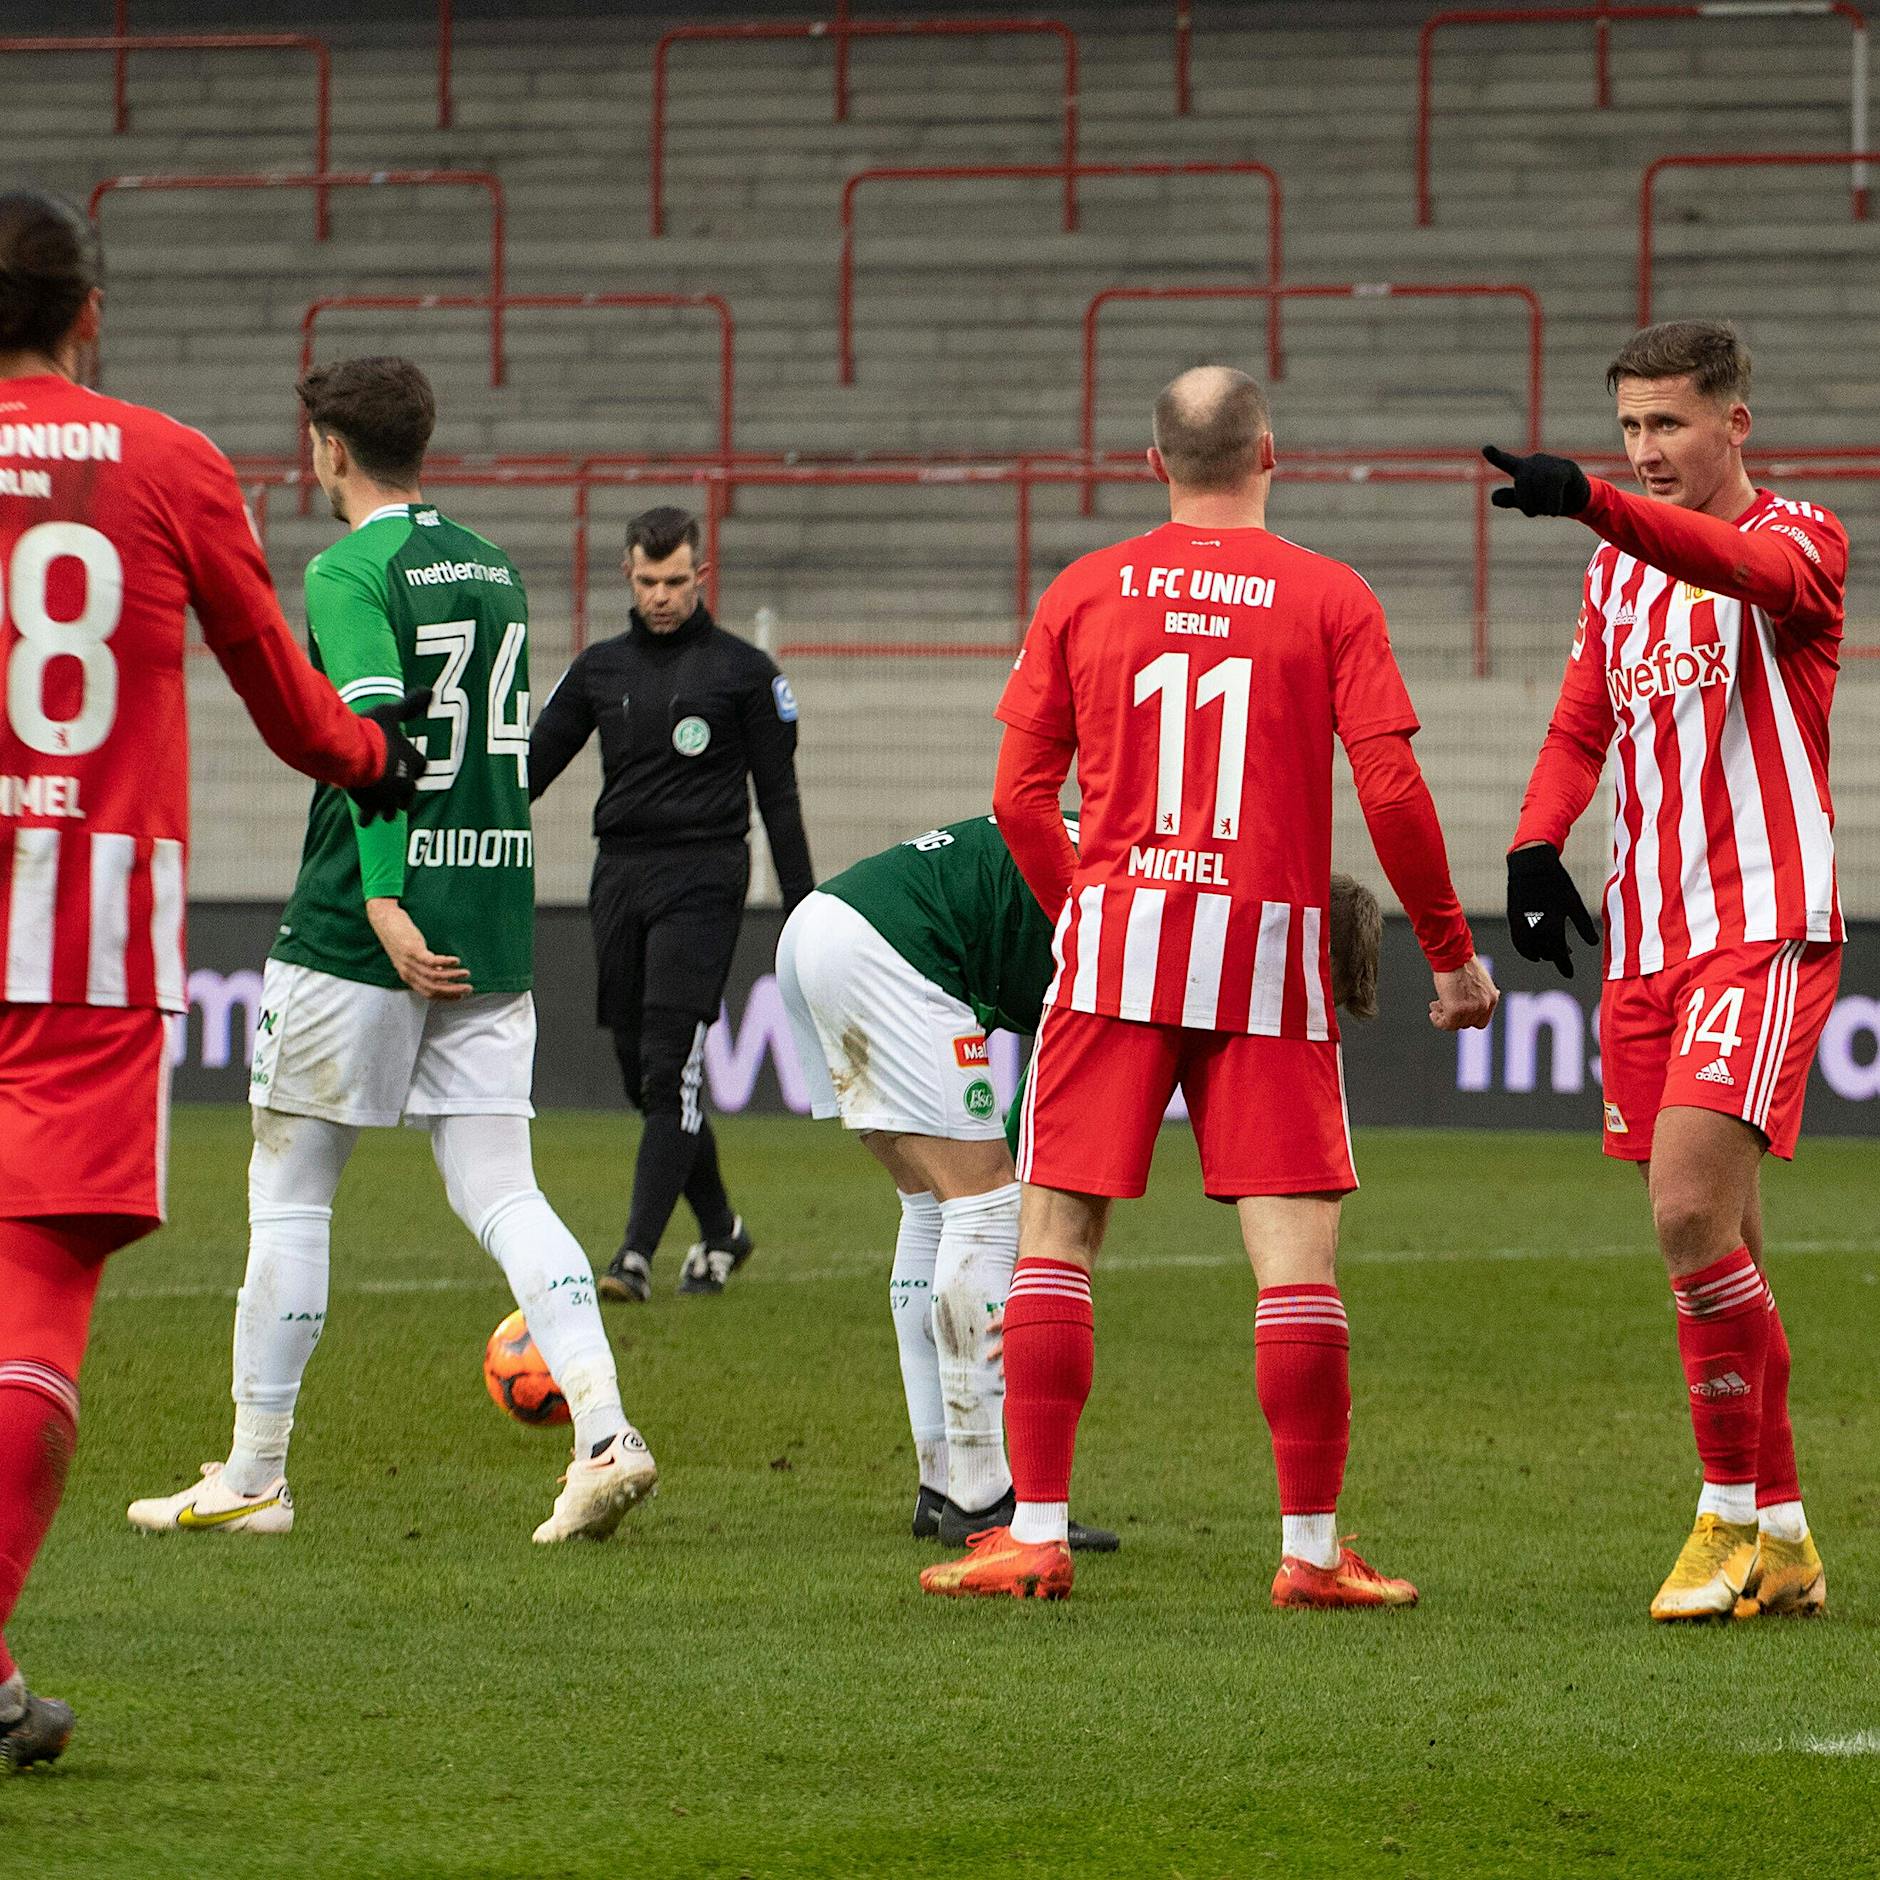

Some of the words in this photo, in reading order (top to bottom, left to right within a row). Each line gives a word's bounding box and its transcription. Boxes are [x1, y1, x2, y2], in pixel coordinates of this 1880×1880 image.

[1119, 565, 1140, 597] 1.
[1147, 567, 1185, 599] FC
[0, 520, 123, 756] 8
[1164, 611, 1231, 638] BERLIN
[1607, 639, 1730, 711] wefox
[411, 618, 530, 791] 34
[1134, 651, 1253, 841] 11
[1127, 845, 1230, 886] MICHEL
[1679, 986, 1745, 1057] 14
[1695, 1071, 1735, 1086] adidas
[548, 1274, 593, 1291] JAK
[280, 1311, 326, 1322] JAK
